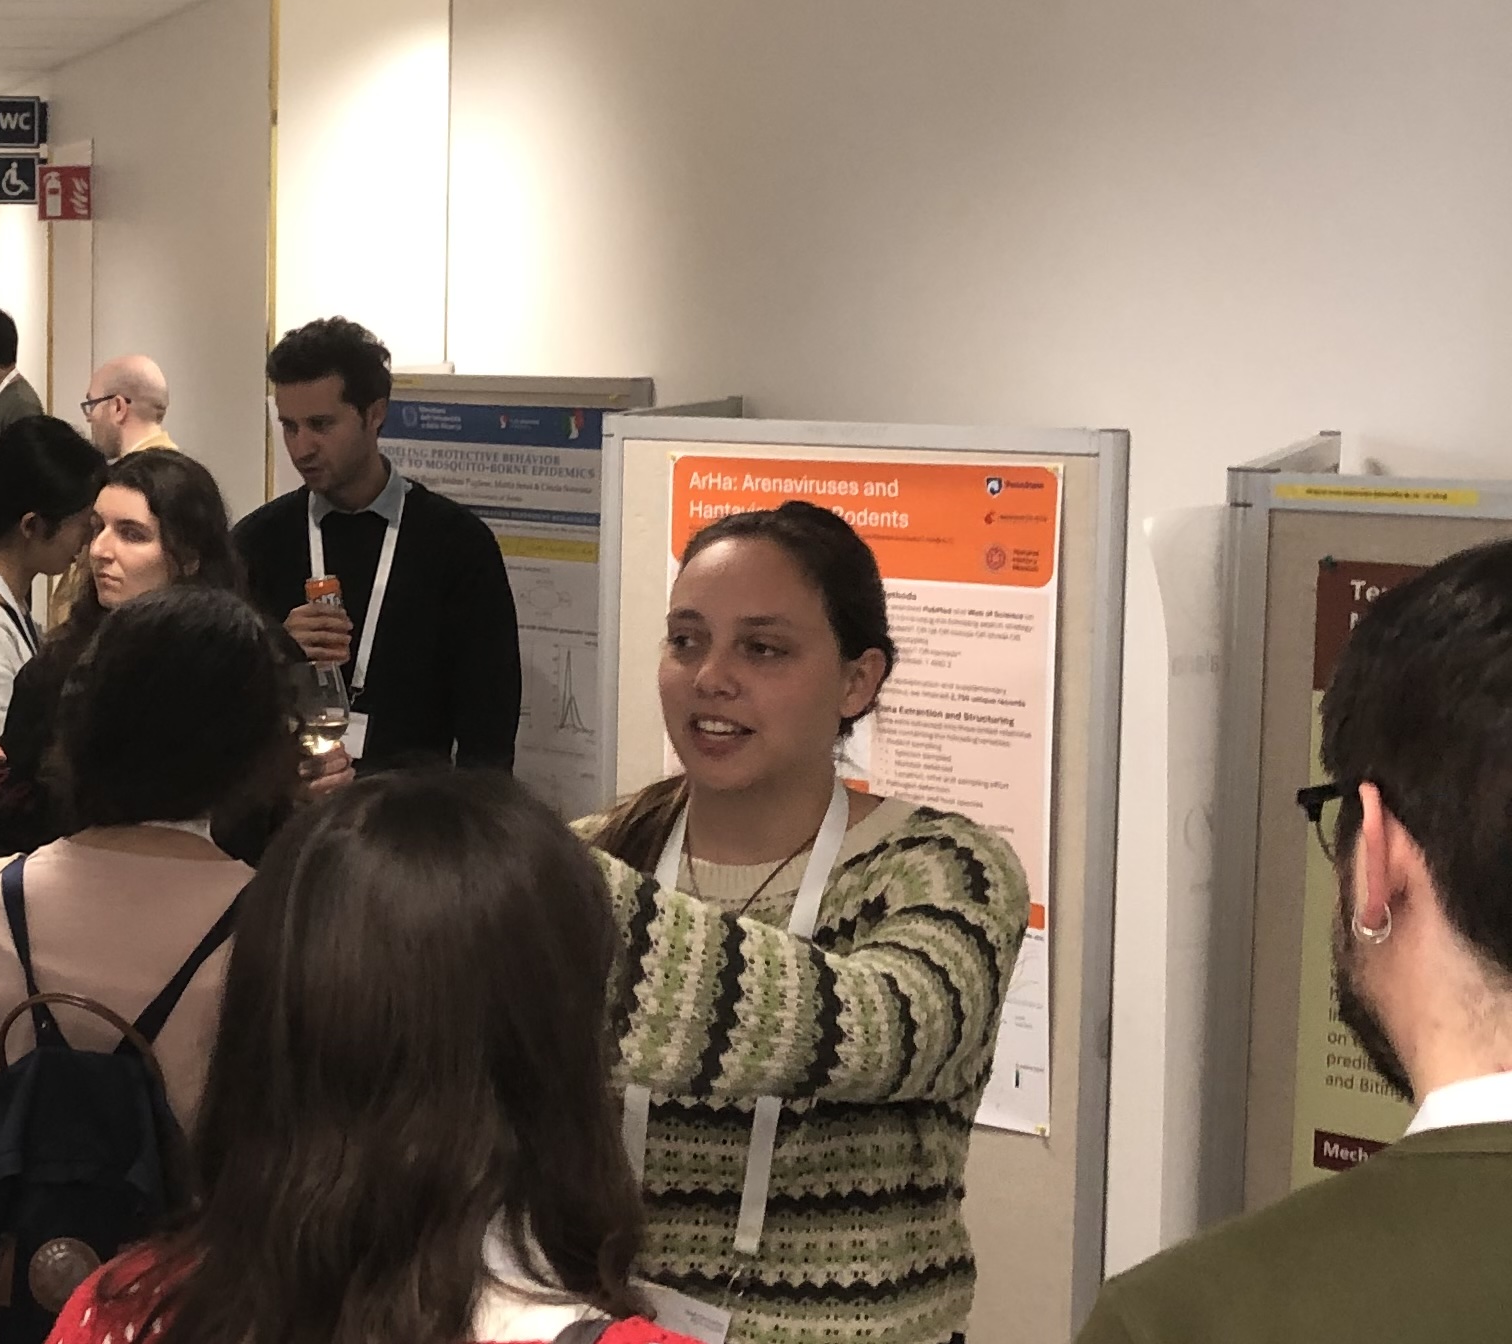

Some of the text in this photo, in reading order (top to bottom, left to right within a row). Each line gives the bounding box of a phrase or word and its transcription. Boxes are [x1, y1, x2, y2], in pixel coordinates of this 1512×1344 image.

[380, 445, 561, 466] ODELING PROTECTIVE BEHAVIOR
[531, 465, 595, 479] EPIDEMICS
[689, 471, 899, 497] ArHa: Arenaviruses and
[1350, 579, 1389, 603] Te
[1327, 1032, 1347, 1047] on
[1325, 1074, 1354, 1090] and
[1323, 1140, 1370, 1163] Mech
